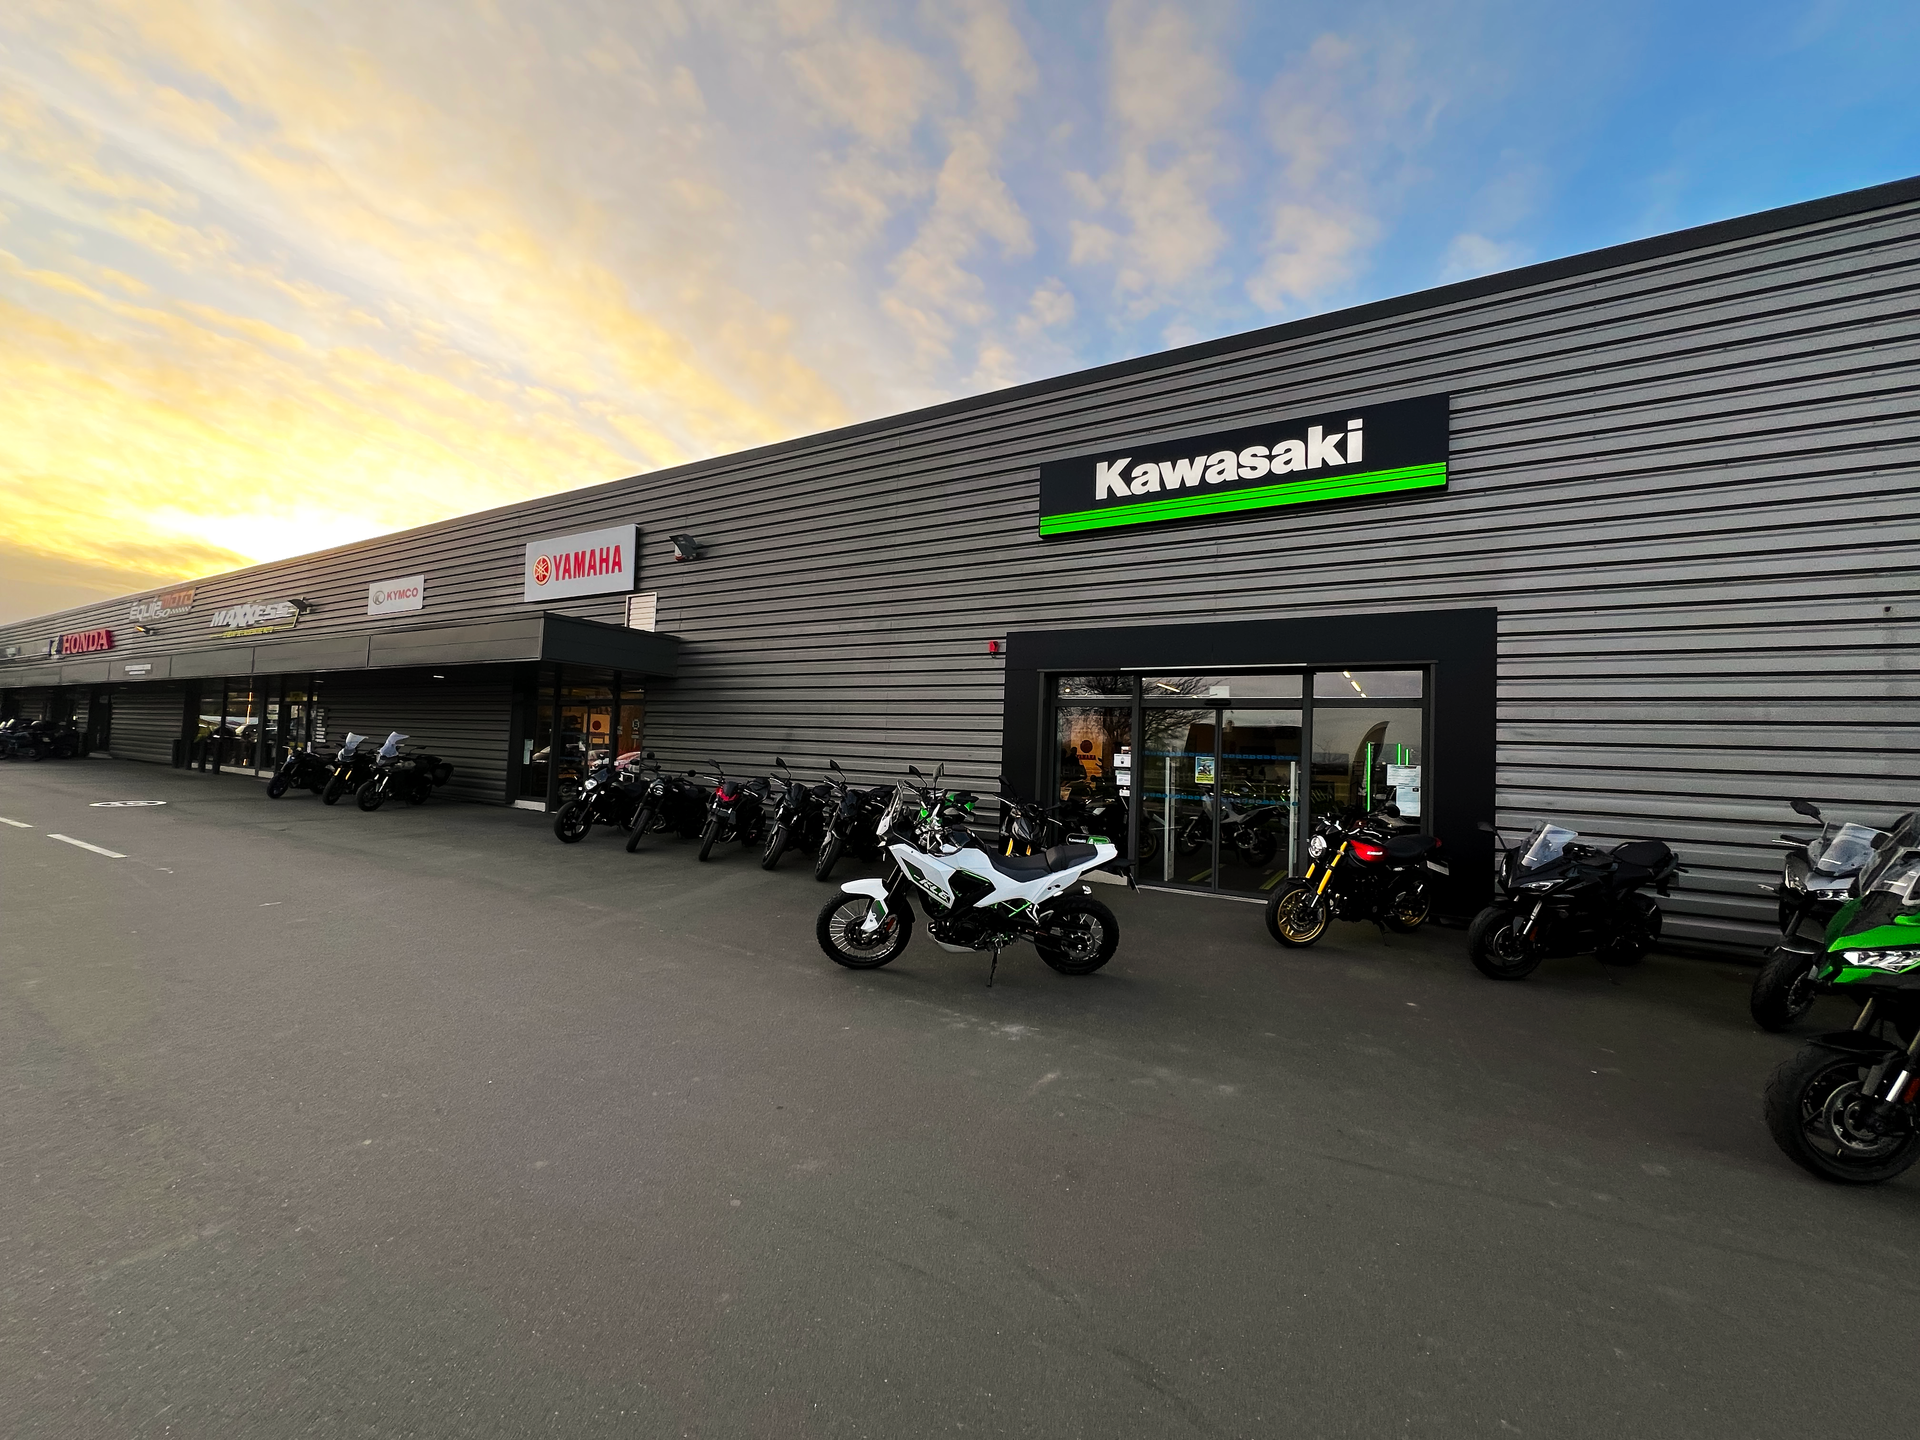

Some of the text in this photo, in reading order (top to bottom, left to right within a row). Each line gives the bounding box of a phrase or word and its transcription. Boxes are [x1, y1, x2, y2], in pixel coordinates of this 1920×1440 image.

[1095, 418, 1364, 501] Kawasaki
[552, 544, 623, 582] YAMAHA
[386, 586, 419, 602] KYMCO
[210, 602, 291, 628] MAXXESS
[62, 629, 109, 655] HONDA
